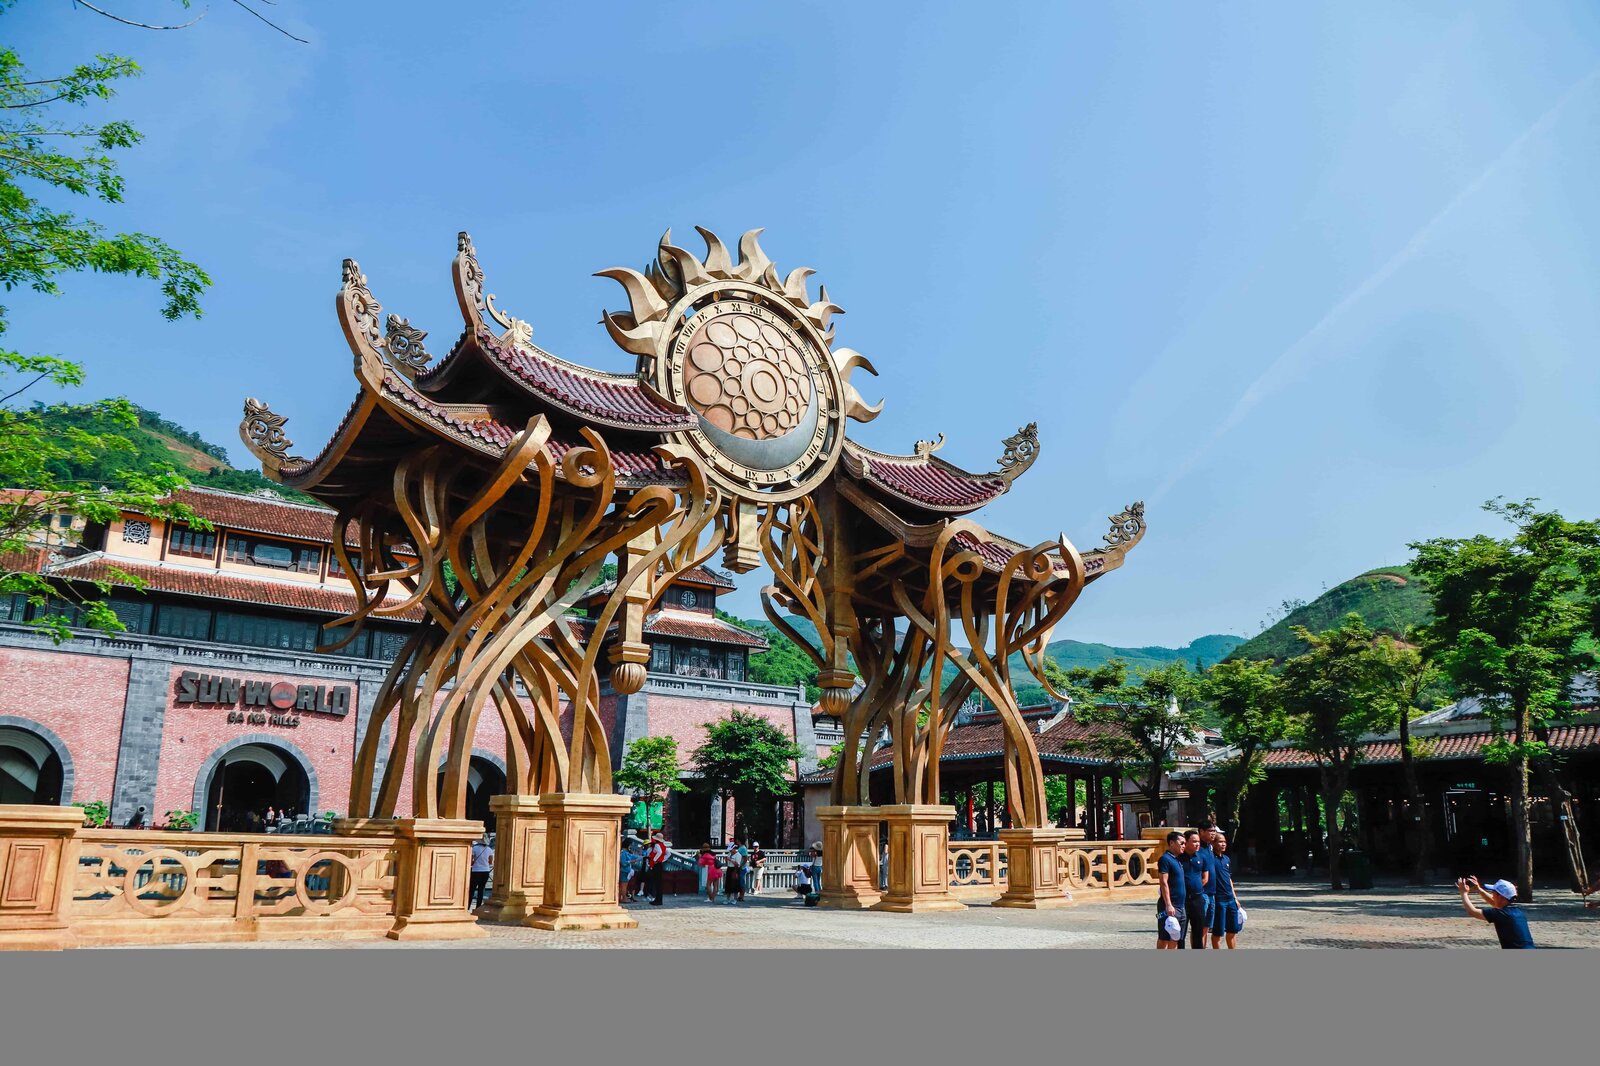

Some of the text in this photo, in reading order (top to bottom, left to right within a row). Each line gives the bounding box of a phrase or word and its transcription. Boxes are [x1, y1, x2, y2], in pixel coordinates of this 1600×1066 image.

[178, 670, 351, 716] SUN WORLD
[271, 713, 300, 726] HILLS
